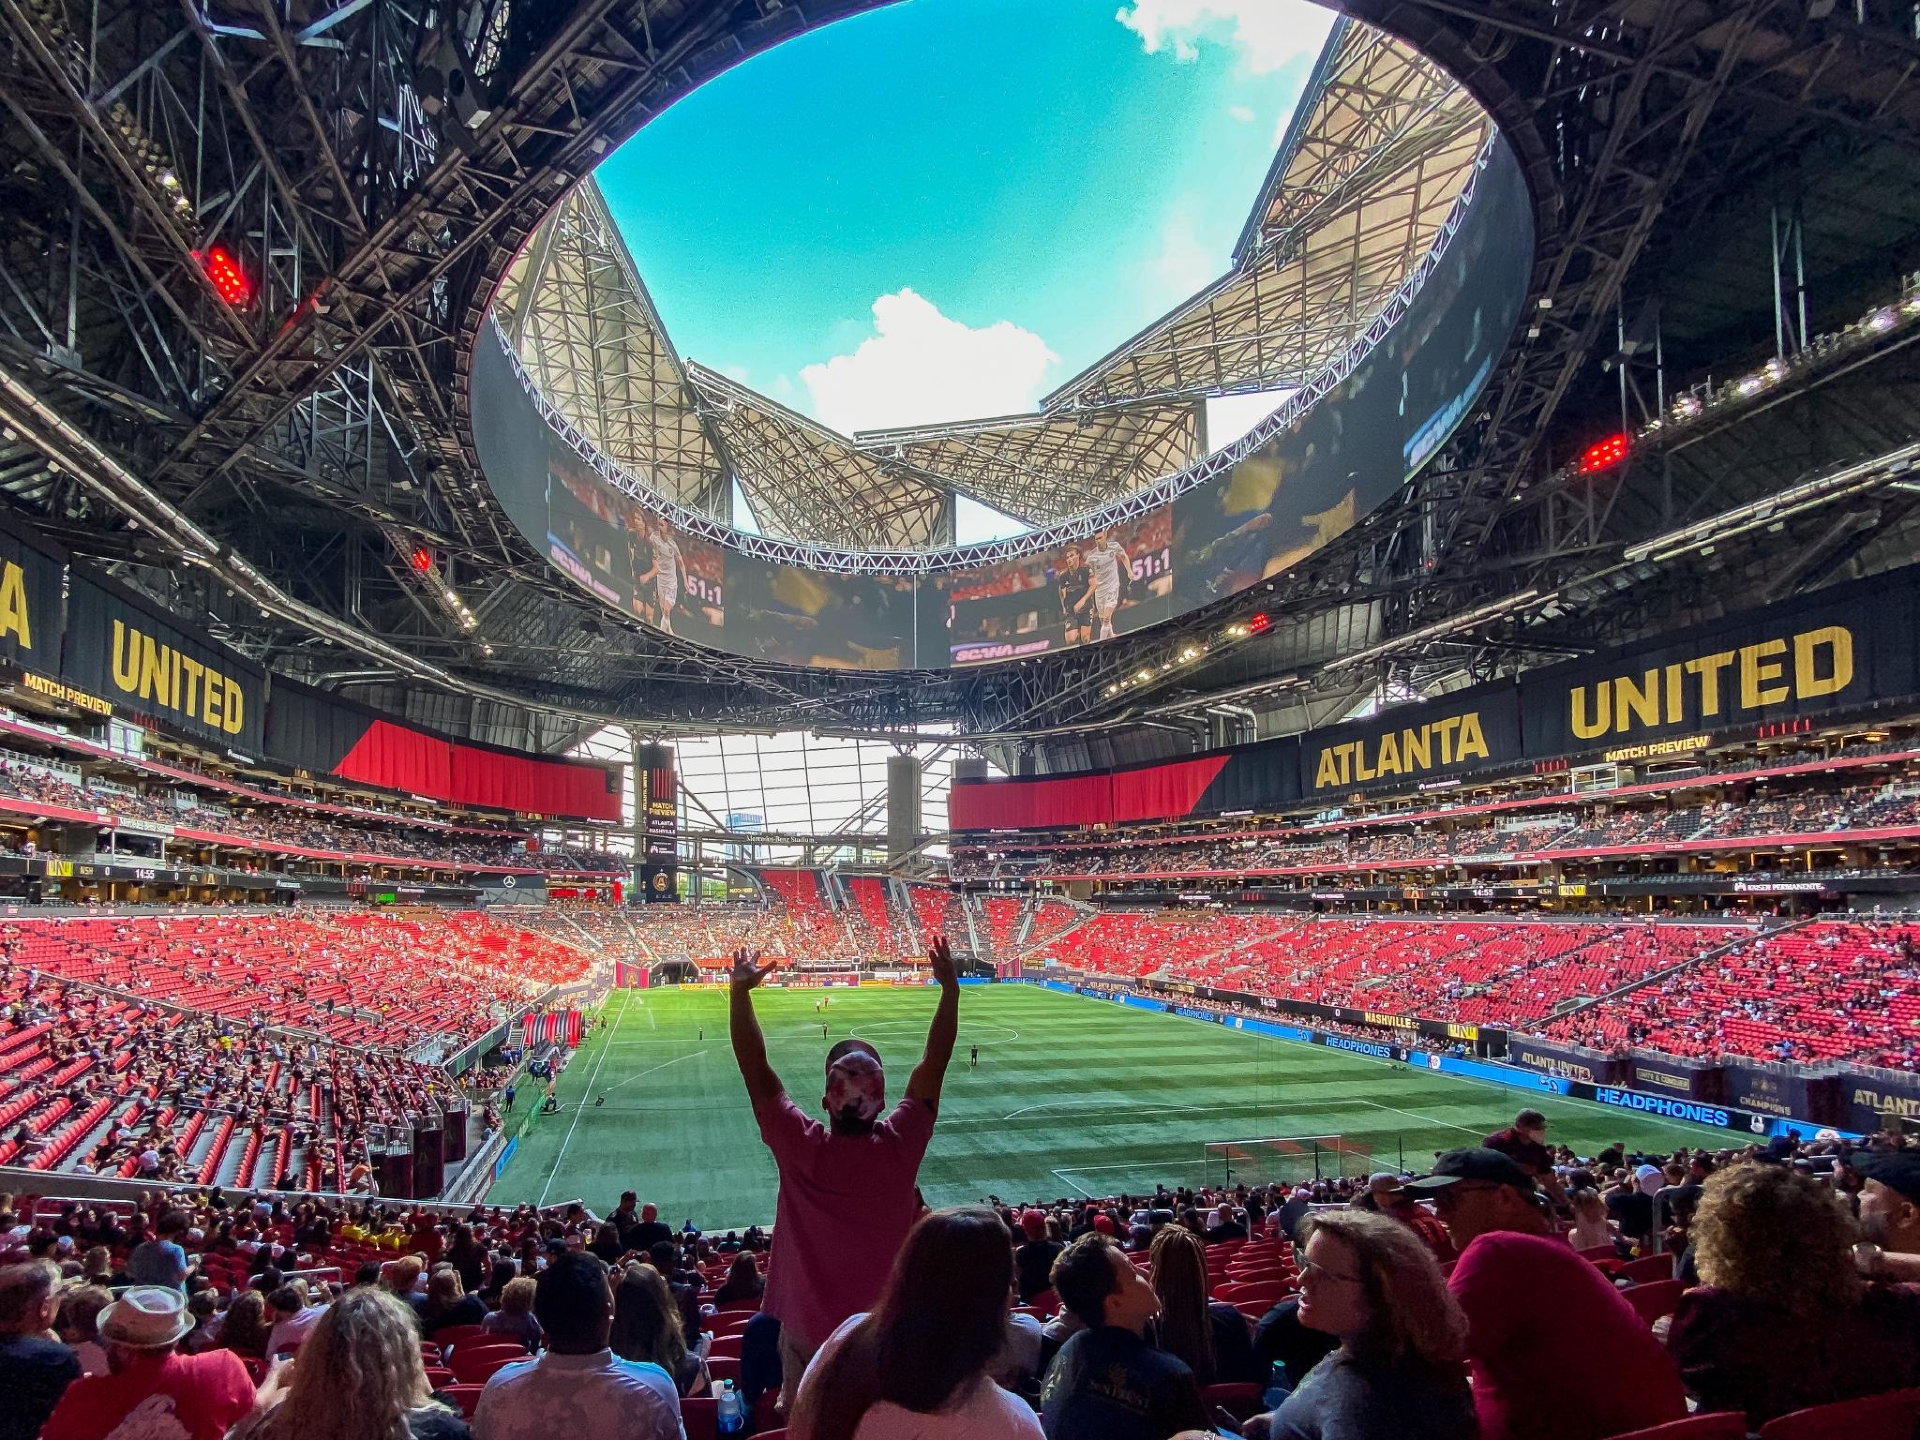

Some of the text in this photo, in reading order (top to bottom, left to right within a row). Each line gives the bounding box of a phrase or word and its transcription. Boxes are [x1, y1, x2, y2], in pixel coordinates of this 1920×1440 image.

[113, 619, 244, 735] UNITED
[1570, 626, 1853, 739] UNITED
[24, 672, 113, 715] MATCH PREVIEW
[1315, 712, 1489, 788] ATLANTA
[1605, 735, 1710, 762] MATCH PREVIEW
[649, 808, 676, 816] PREVIEW
[105, 867, 110, 876] 0
[135, 868, 154, 879] 14:55
[174, 872, 179, 880] 0
[1472, 889, 1493, 897] 14:55
[1175, 1007, 1214, 1021] HEADPHONES
[1335, 1009, 1340, 1017] 0
[1365, 1011, 1411, 1029] NASHVILLE
[1326, 1036, 1390, 1057] HEADPHONES
[1522, 1052, 1556, 1069] ATLANTA
[1596, 1087, 1728, 1127] HEADPHONES
[1740, 1096, 1791, 1115] CHAMPIONS
[1853, 1088, 1920, 1116] ATLANT
